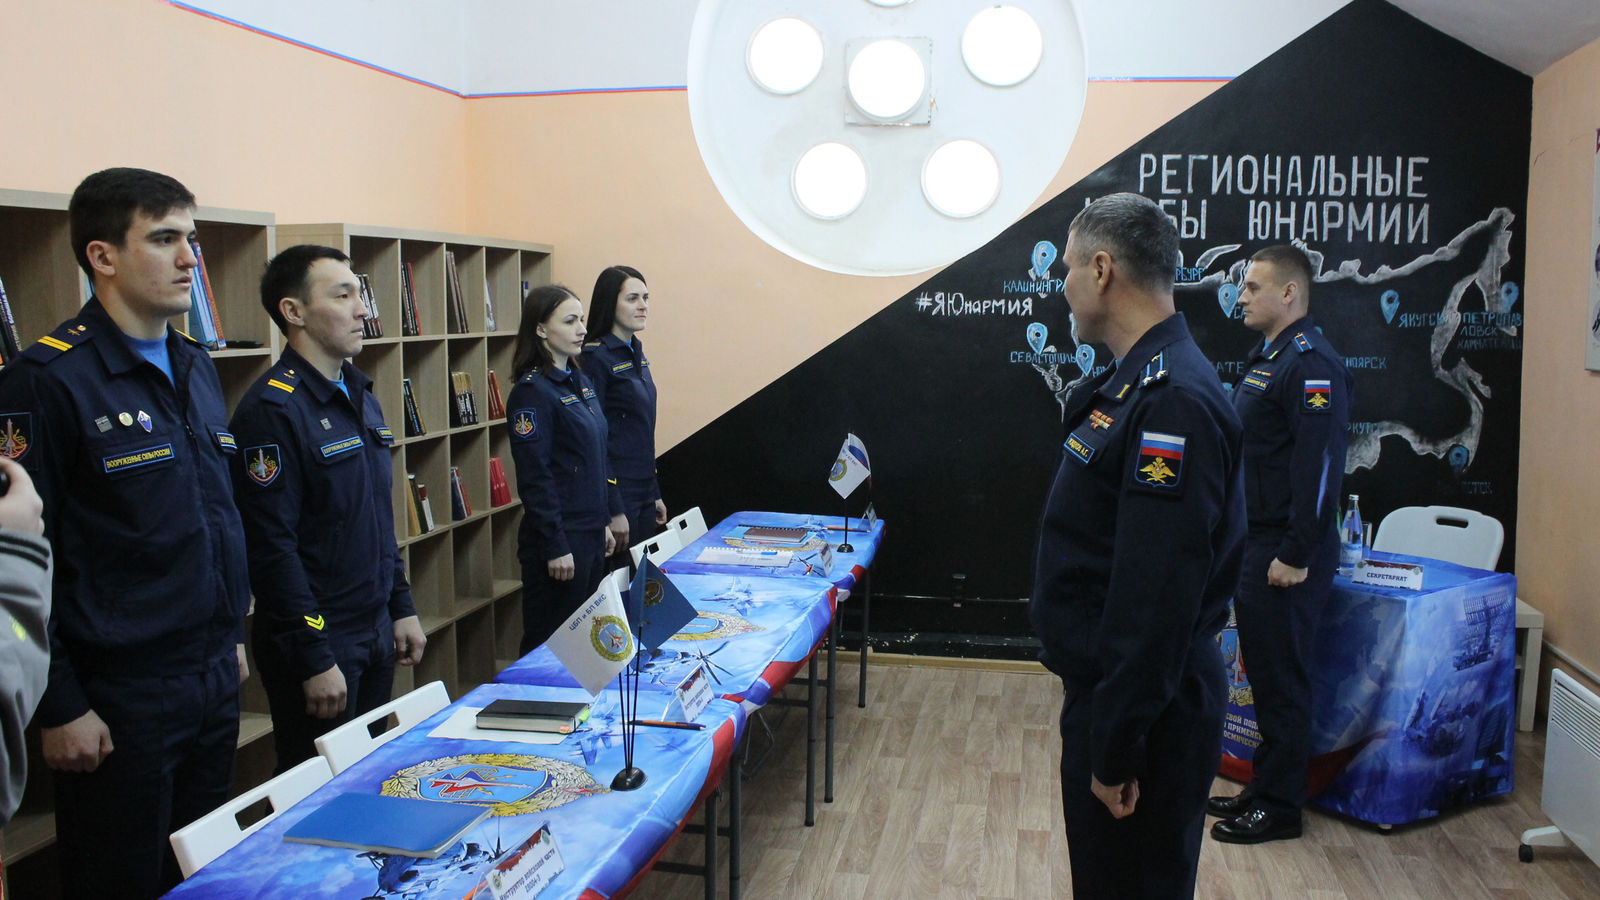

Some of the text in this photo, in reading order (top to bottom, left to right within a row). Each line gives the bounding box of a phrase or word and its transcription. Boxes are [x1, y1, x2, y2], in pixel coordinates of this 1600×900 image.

[1138, 153, 1430, 198] РЕГИОНАЛЬНЫЕ
[1248, 200, 1430, 244] ЮНАРМИИ
[1003, 279, 1066, 293] КАЛИНИНГРА
[1344, 356, 1387, 369] НОЯРСК
[1366, 572, 1408, 582] СЕКРЕТАРИАТ
[569, 616, 583, 631] ЦБП
[585, 604, 596, 615] БП
[594, 593, 607, 607] ВКС
